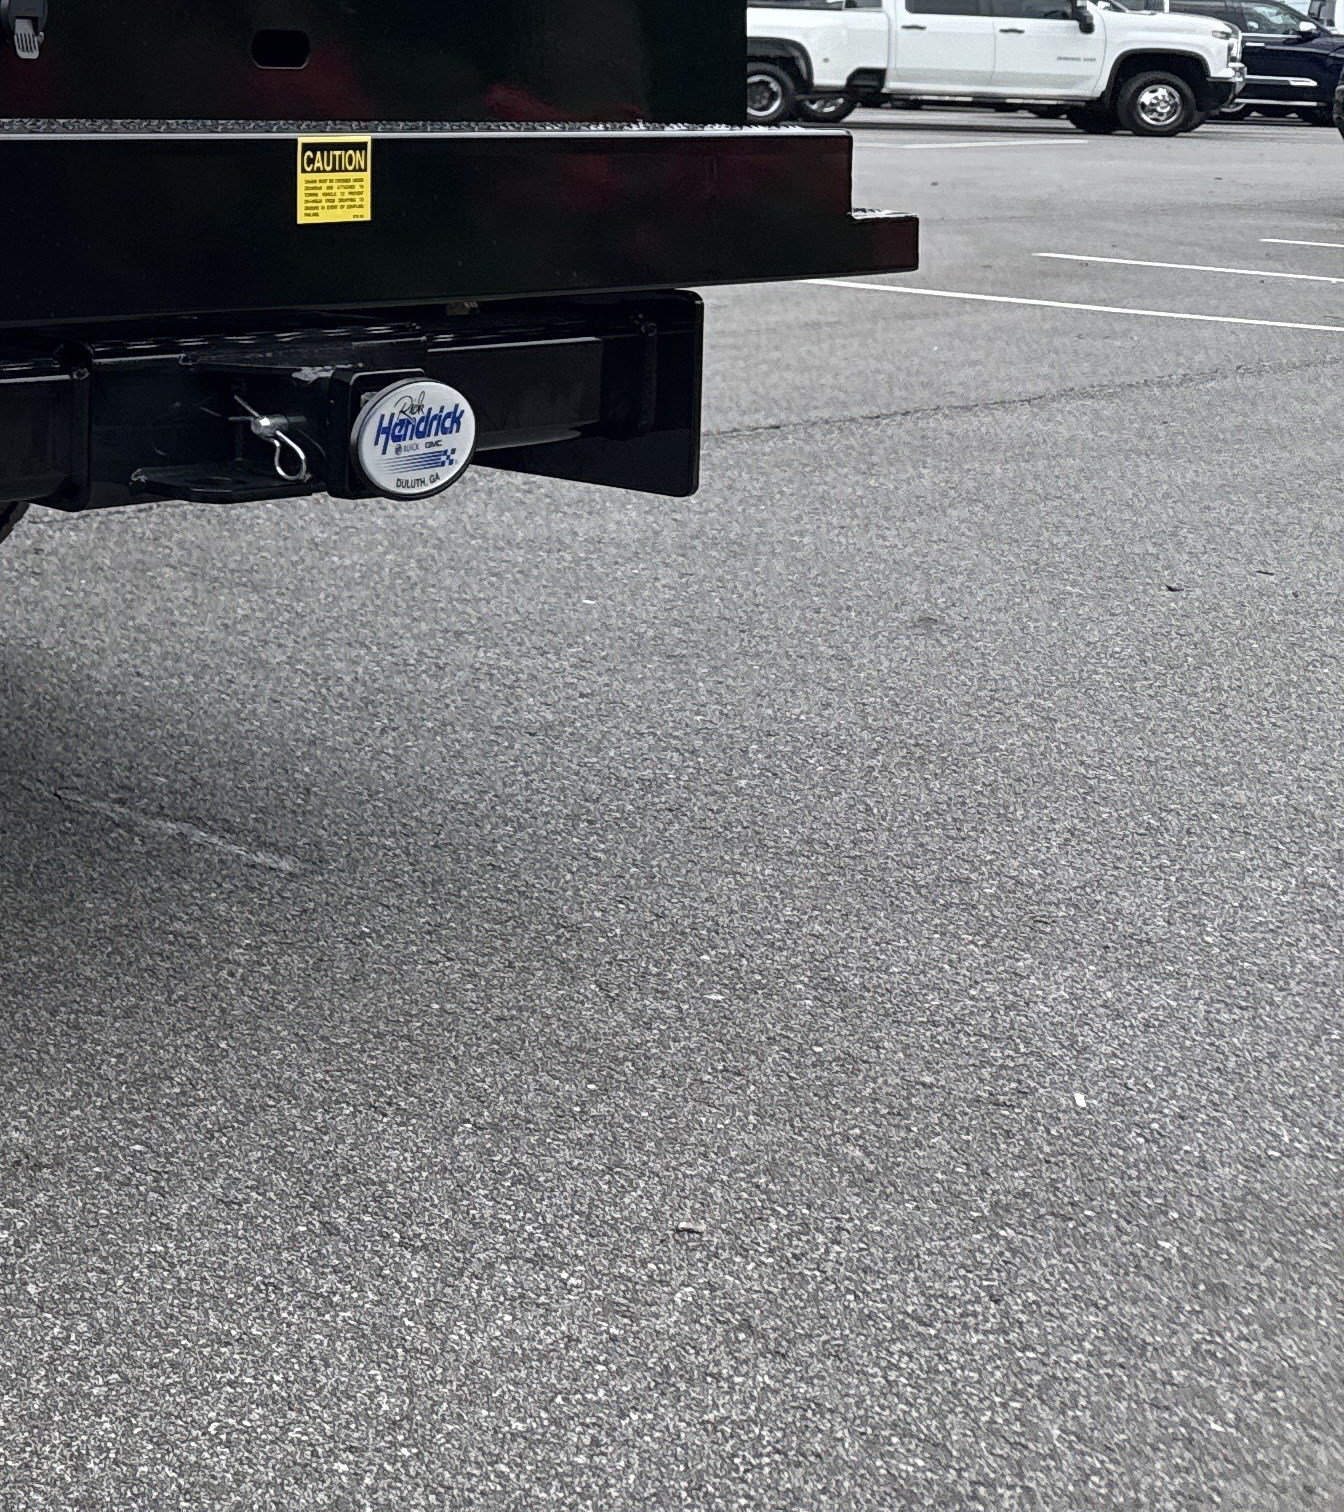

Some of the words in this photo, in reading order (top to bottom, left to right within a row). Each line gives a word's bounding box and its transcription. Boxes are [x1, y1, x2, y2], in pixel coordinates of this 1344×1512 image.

[304, 150, 365, 171] CAUTION
[374, 403, 465, 455] Hendrick
[425, 439, 442, 449] GMC
[429, 473, 441, 484] GA
